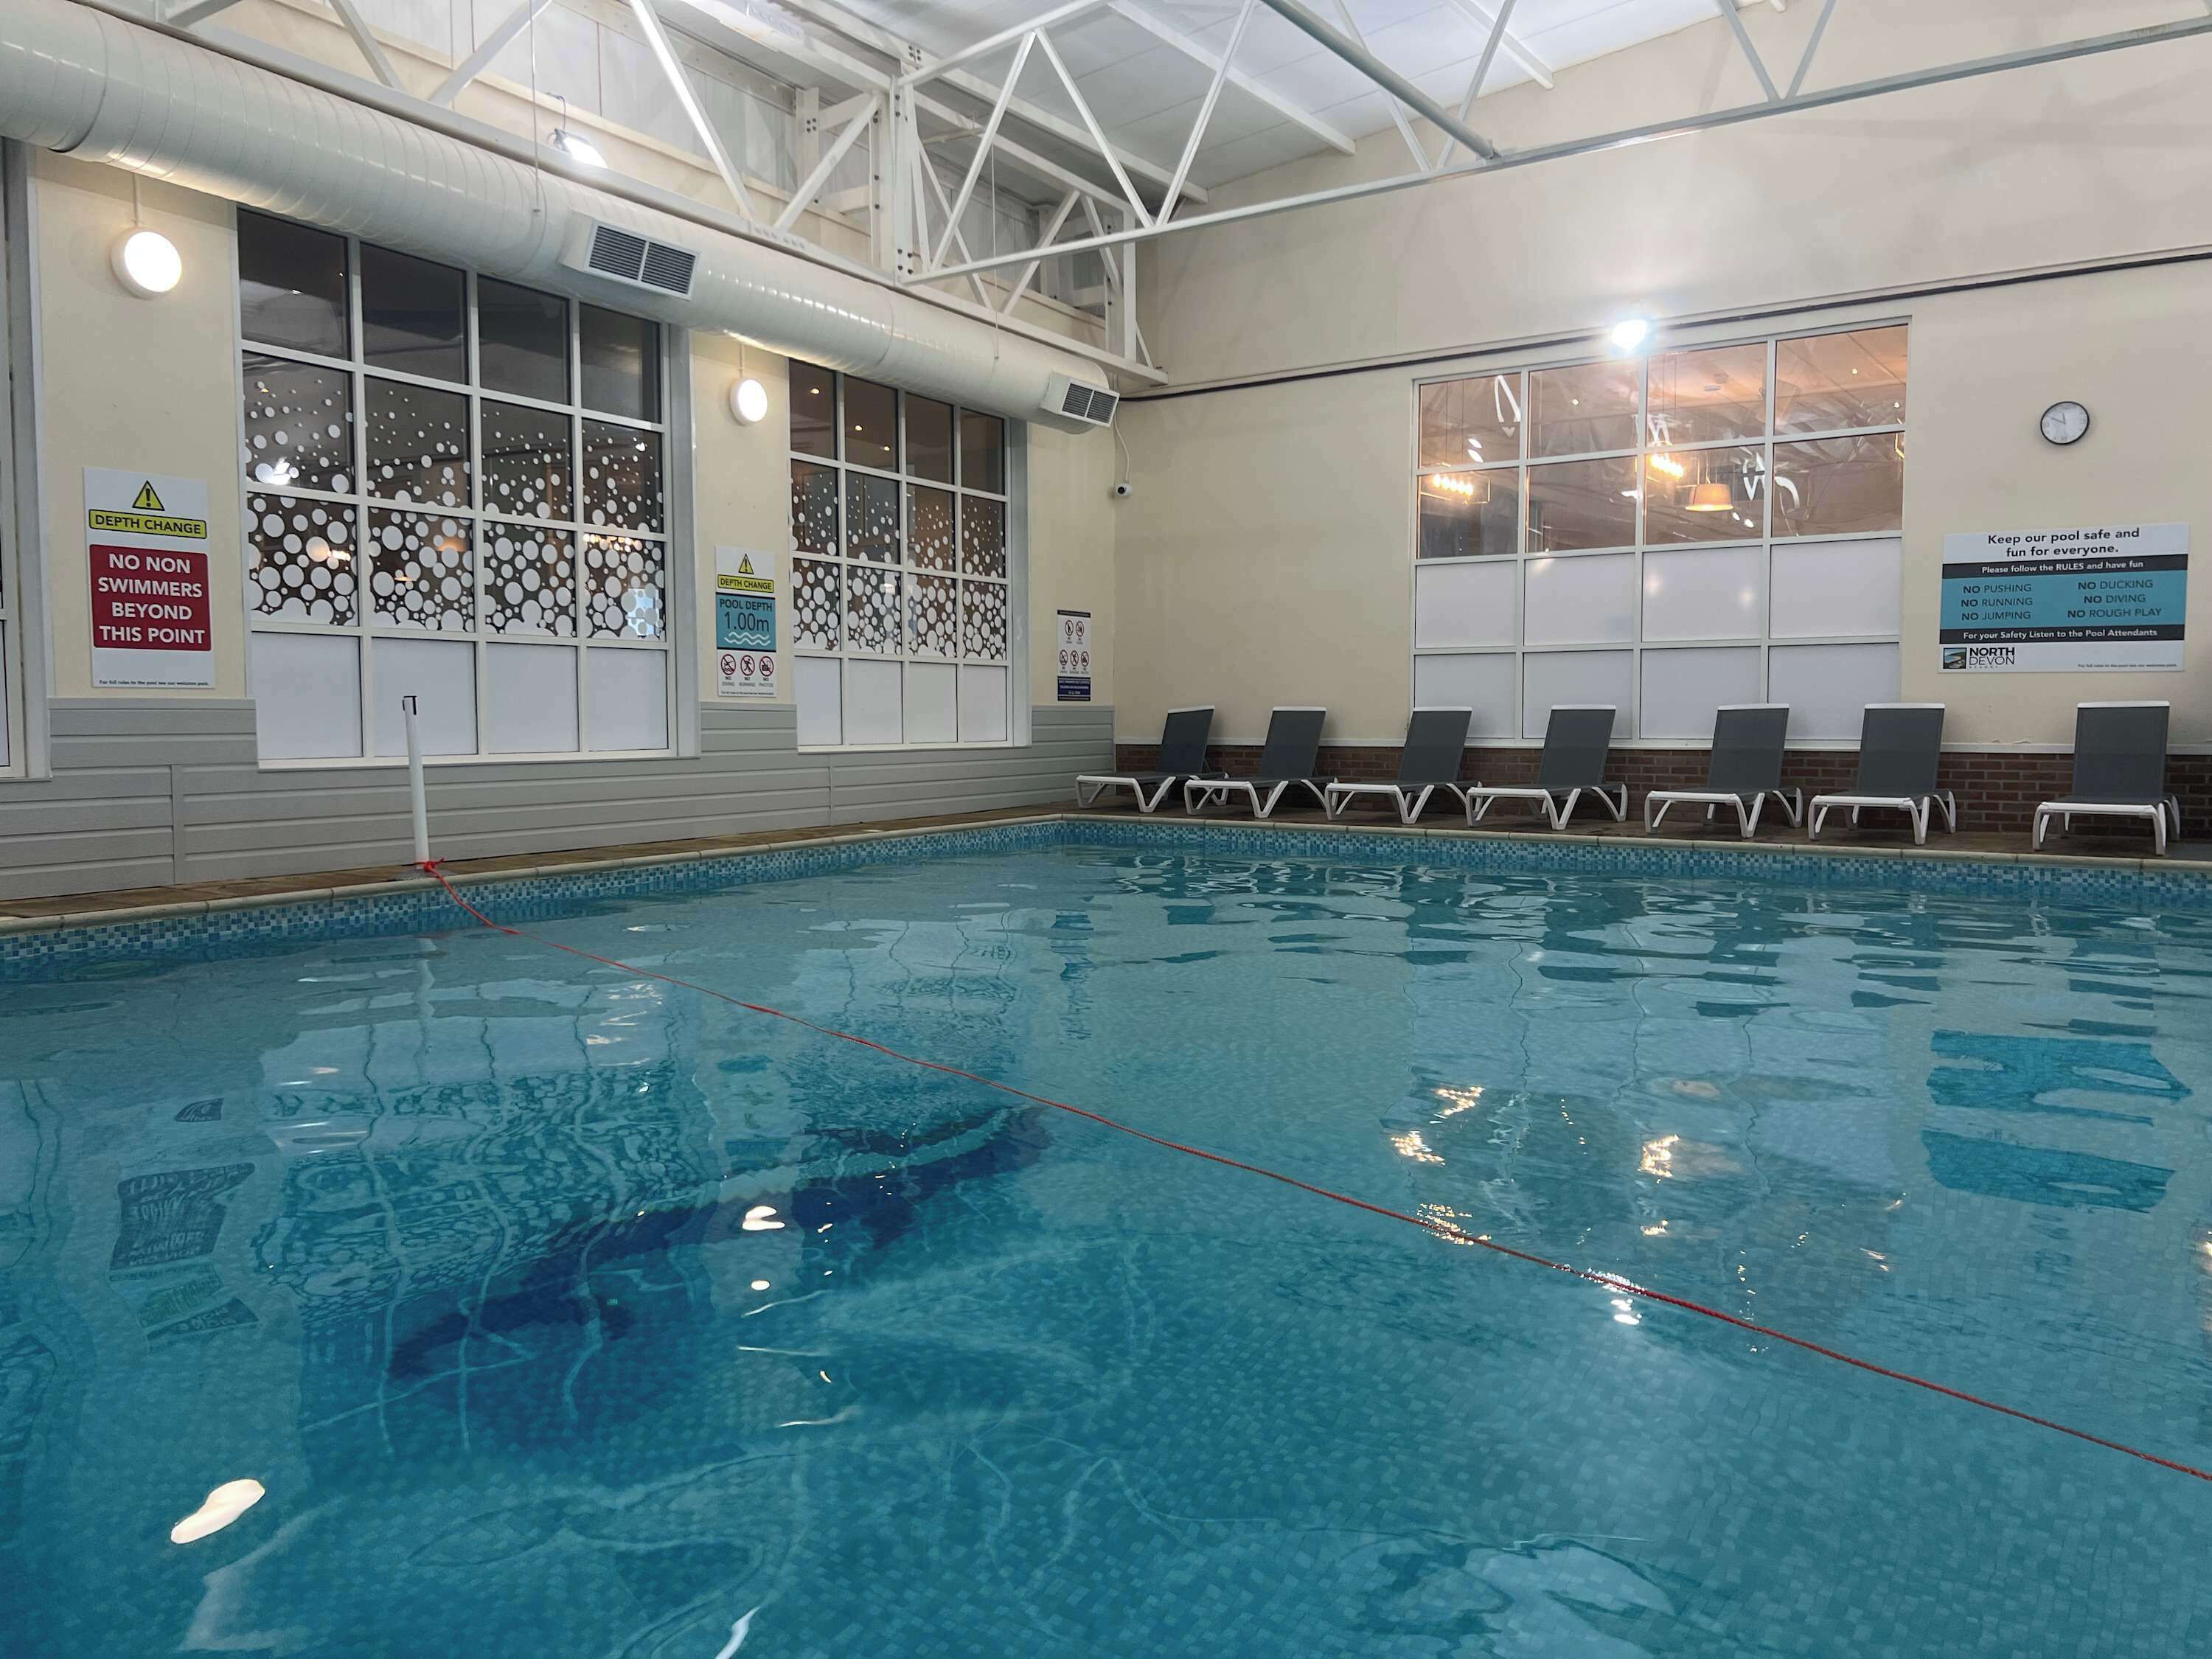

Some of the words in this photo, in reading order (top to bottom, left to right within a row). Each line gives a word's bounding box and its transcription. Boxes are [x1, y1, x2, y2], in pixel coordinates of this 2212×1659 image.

[95, 515, 140, 529] DEPTH
[144, 519, 201, 535] CHANGE
[1988, 535, 2020, 546] Keep
[2051, 530, 2079, 543] pool
[2084, 529, 2111, 540] safe
[2115, 528, 2140, 538] and
[2006, 548, 2026, 557] fun
[2031, 546, 2049, 556] for
[2053, 546, 2118, 557] everyone.
[108, 554, 140, 571] NO
[146, 557, 190, 574] NON
[1982, 566, 2008, 574] Please
[2011, 564, 2037, 573] follow
[2056, 563, 2084, 571] RULES
[2087, 562, 2104, 570] and
[2106, 561, 2126, 569] have
[98, 577, 203, 598] SWIMMERS
[720, 577, 742, 588] DEPTH
[743, 580, 772, 591] CHANGE
[1963, 585, 1980, 594] NO
[1983, 583, 2032, 593] PUSHING
[2078, 582, 2096, 590] NO
[2100, 580, 2153, 590] DUCKING
[1961, 599, 1978, 607] NO
[1982, 597, 2033, 607] RUNNING
[2106, 594, 2146, 603] DIVING
[111, 602, 192, 620] BEYOND
[720, 599, 744, 609] POOL
[745, 601, 773, 612] DEPTH
[1961, 613, 1979, 621] NO
[1981, 611, 2031, 620] JUMPING
[2067, 610, 2086, 618] NO
[2090, 608, 2131, 618] ROUGH
[2135, 608, 2162, 617] PLAY
[724, 611, 770, 632] 1.00m
[100, 625, 142, 642] THIS
[148, 628, 205, 644] POINT
[1979, 633, 1998, 641] your
[2000, 631, 2027, 639] Safety
[2029, 630, 2054, 639] Listen
[2085, 629, 2106, 637] Pool
[2107, 628, 2158, 637] Attendants
[1969, 647, 2015, 656] NORTH
[1969, 655, 2014, 665] DEVON
